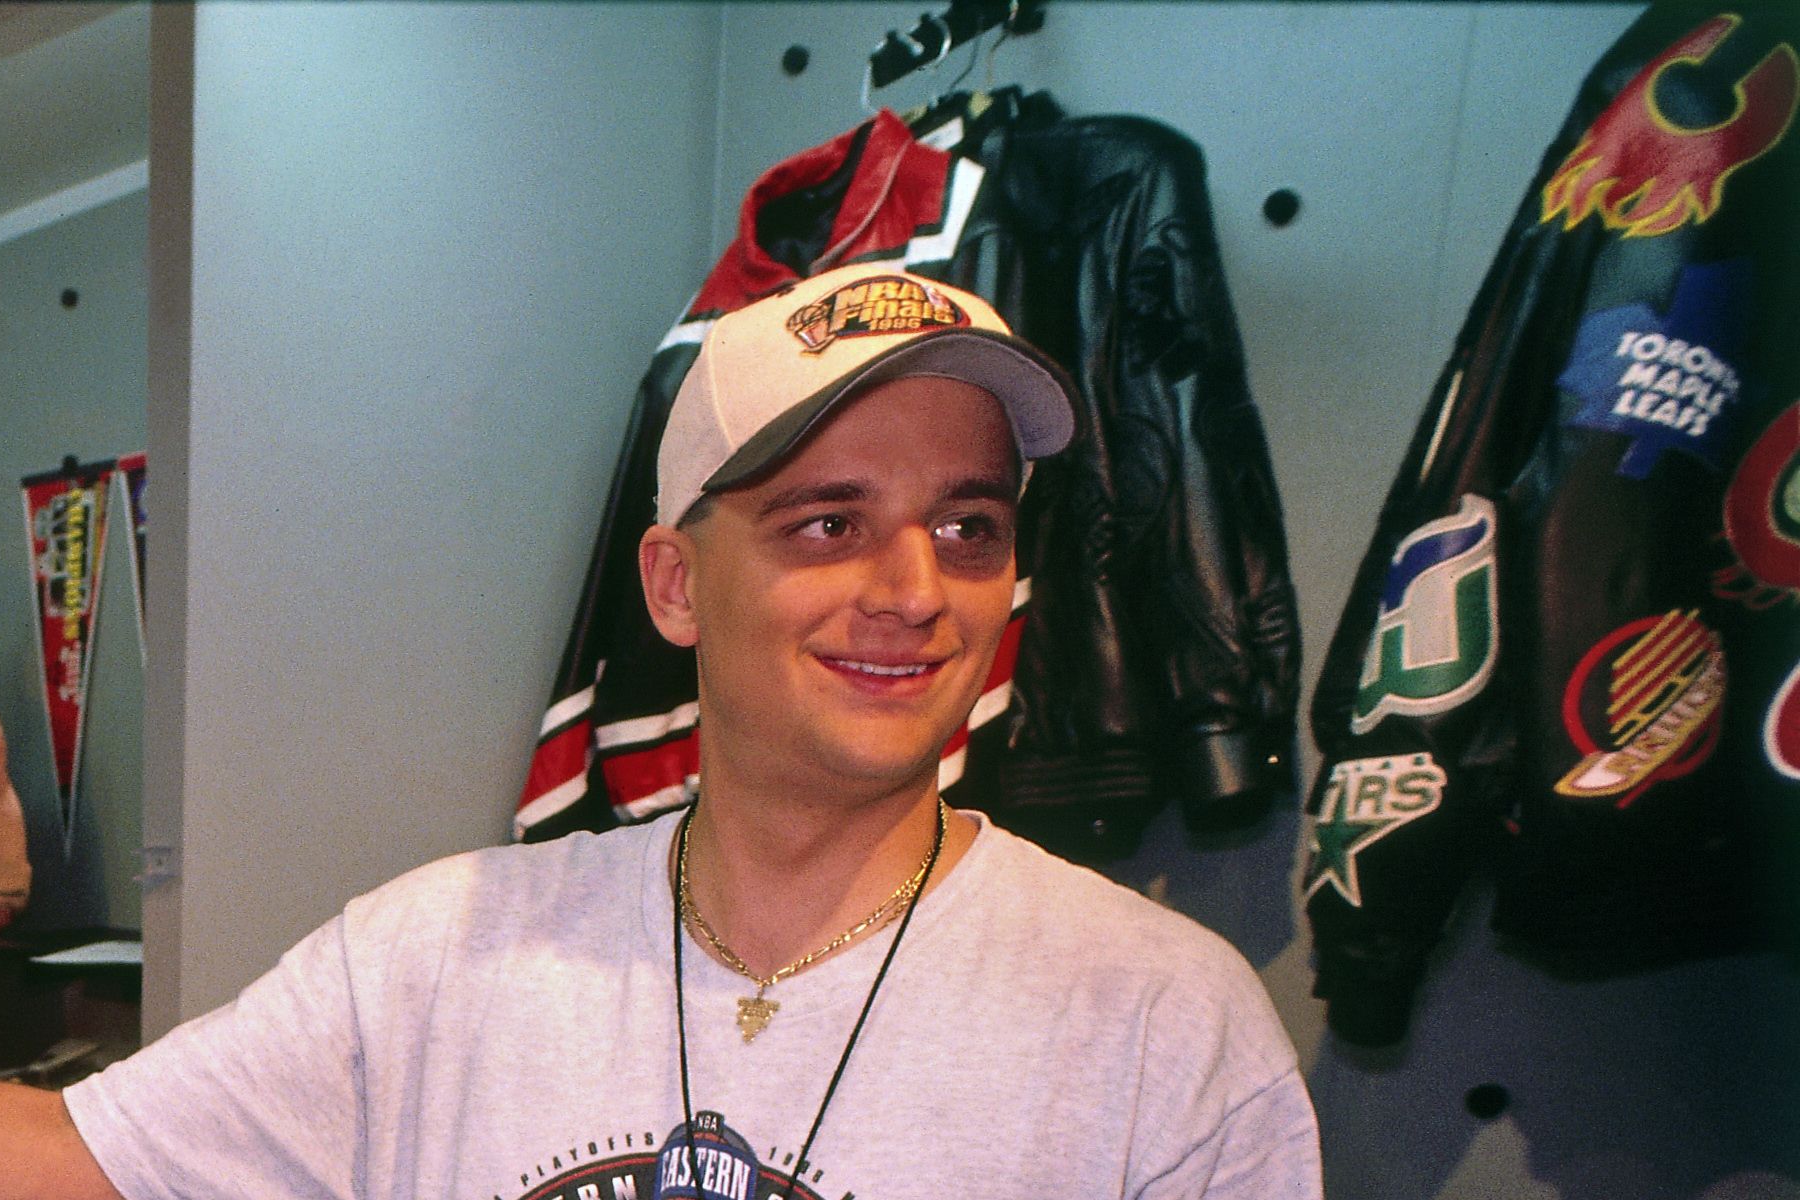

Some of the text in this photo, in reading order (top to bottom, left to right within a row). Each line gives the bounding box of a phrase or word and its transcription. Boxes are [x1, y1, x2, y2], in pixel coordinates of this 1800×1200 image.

[834, 281, 927, 310] NBA
[830, 299, 956, 333] Finals
[869, 317, 923, 331] 1996
[1618, 362, 1726, 416] MAPLE
[1610, 388, 1712, 437] LEAFS
[697, 1114, 718, 1131] NBA
[520, 1132, 655, 1187] PLAYOFFS
